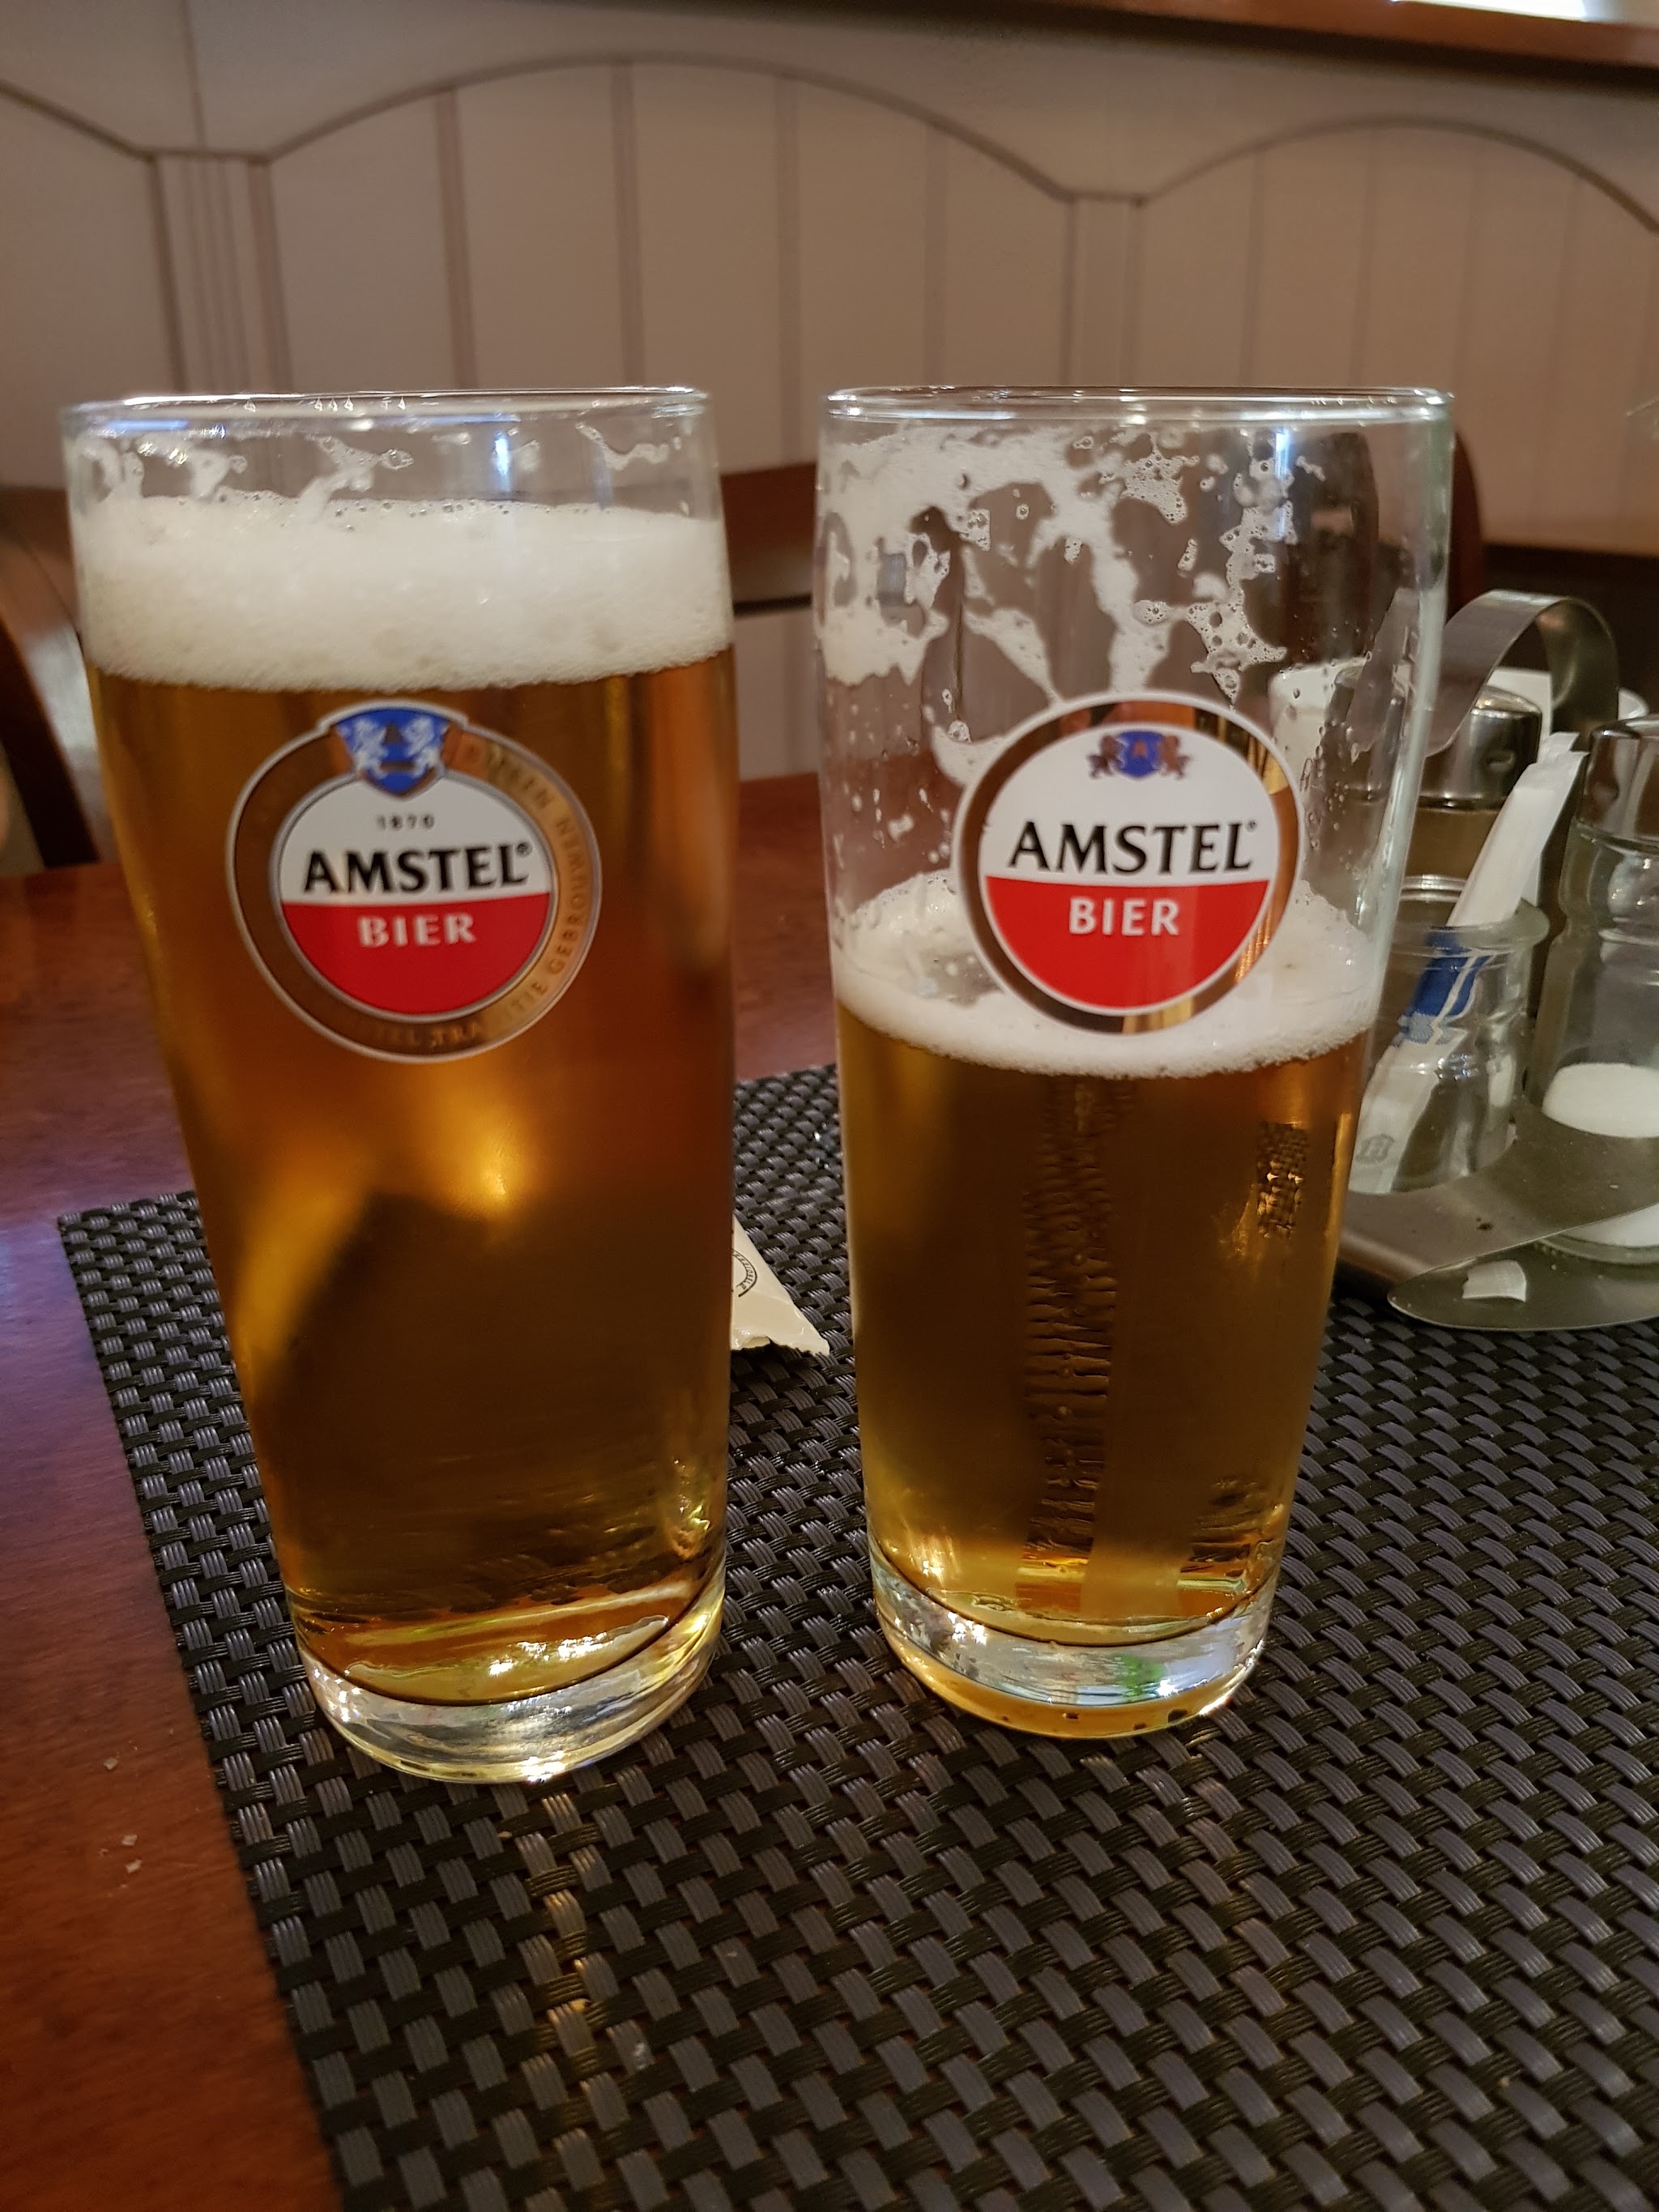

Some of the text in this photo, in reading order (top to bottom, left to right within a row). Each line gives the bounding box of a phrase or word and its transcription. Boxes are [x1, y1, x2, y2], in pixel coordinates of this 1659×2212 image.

[1008, 820, 1251, 875] AMSTEL
[358, 913, 476, 948] BIER
[1068, 897, 1179, 936] BIER
